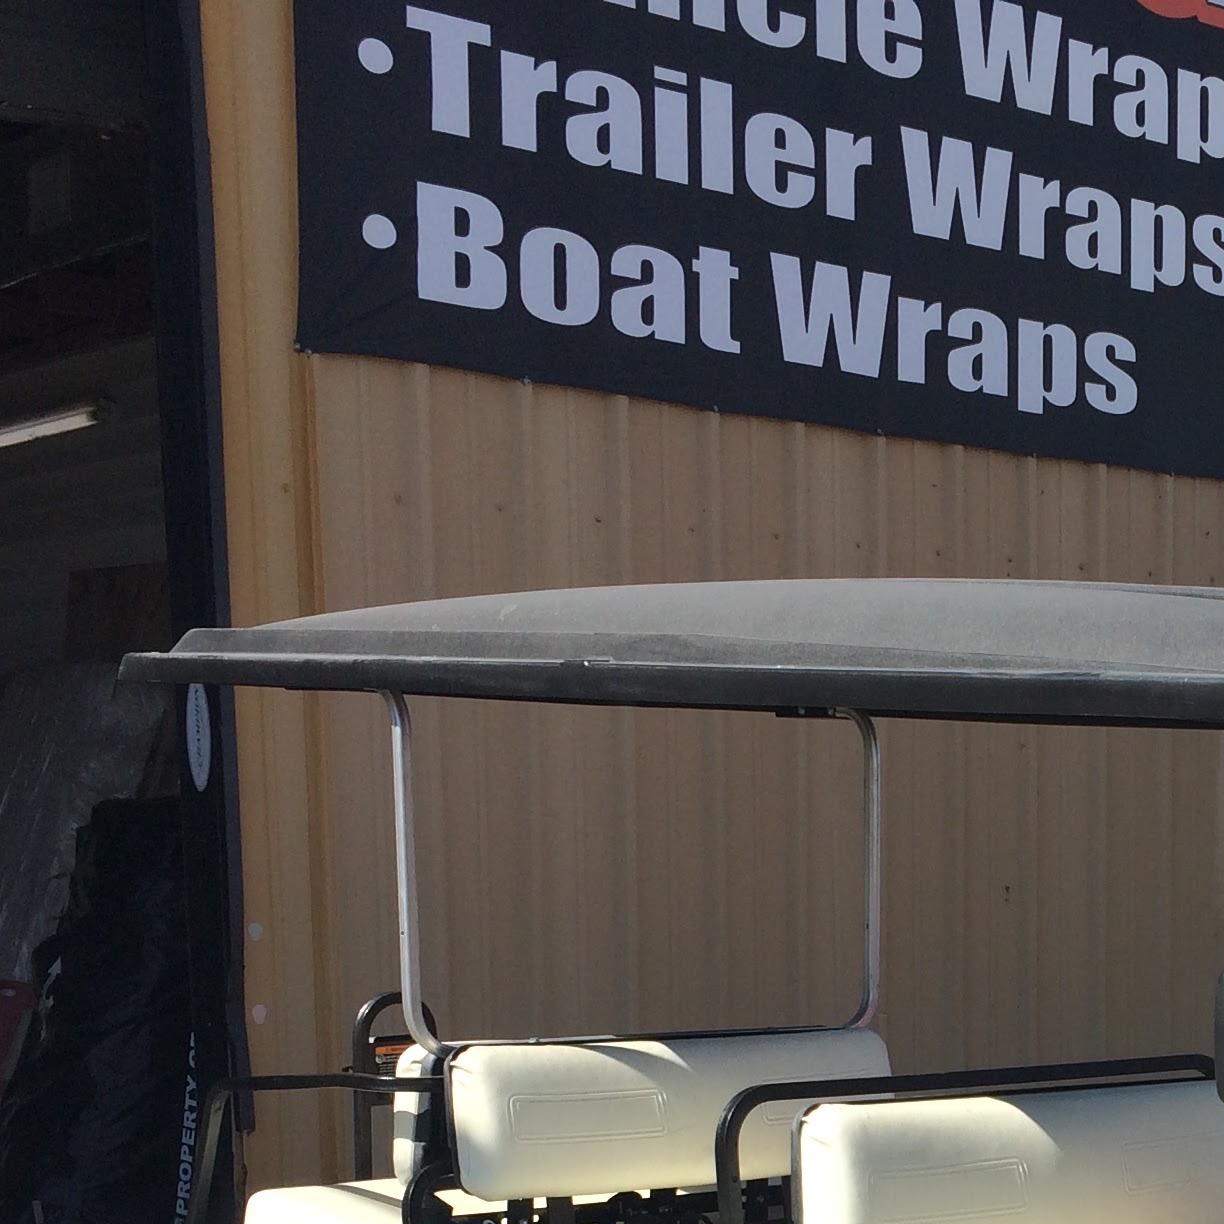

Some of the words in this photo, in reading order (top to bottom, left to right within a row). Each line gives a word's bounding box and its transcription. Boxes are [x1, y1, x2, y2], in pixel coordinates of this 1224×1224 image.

[406, 6, 872, 220] Trailer
[417, 181, 740, 354] Boat
[770, 252, 1138, 415] Wraps
[176, 1075, 198, 1216] PROPERTY
